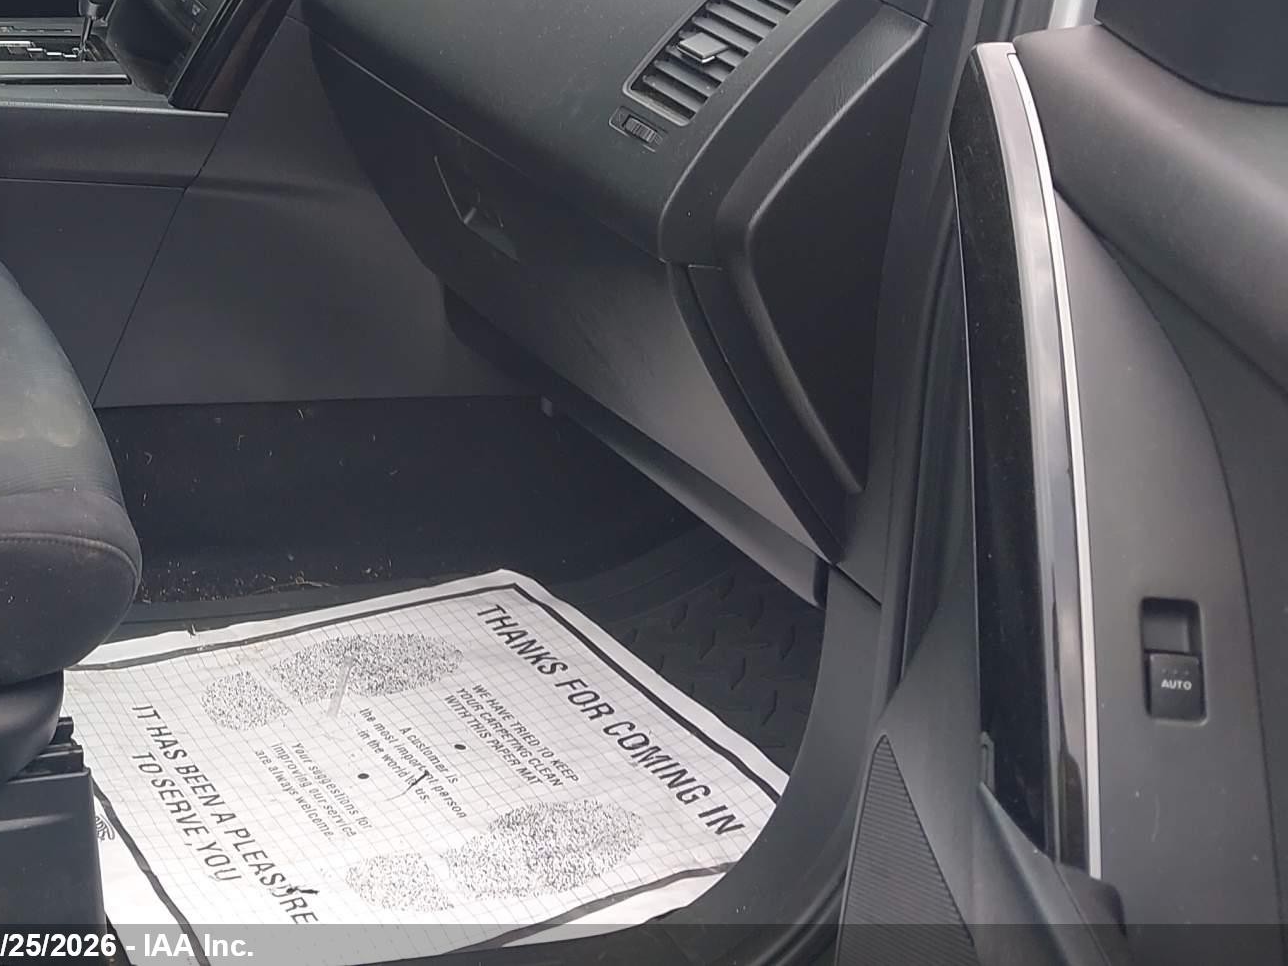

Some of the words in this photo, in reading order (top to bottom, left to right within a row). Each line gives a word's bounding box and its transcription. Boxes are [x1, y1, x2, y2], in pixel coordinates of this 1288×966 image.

[132, 705, 161, 720] IT
[477, 604, 569, 675] THANKS
[555, 678, 615, 720] FOR
[603, 721, 711, 805] COMING
[698, 805, 746, 835] IN
[1160, 679, 1192, 691] AUTO
[146, 725, 187, 760] HAS
[357, 729, 371, 740] in
[367, 739, 385, 754] the
[381, 753, 412, 778] world
[359, 707, 376, 722] the
[373, 723, 399, 744] most
[394, 743, 440, 784] importnt
[430, 785, 468, 818] person
[399, 726, 412, 735] A
[407, 735, 449, 773] customer
[445, 774, 458, 784] is
[444, 695, 472, 719] WITH
[467, 718, 492, 739] THIS
[486, 738, 521, 766] PAPER
[516, 767, 543, 785] MAT
[456, 688, 484, 712] YOUR
[479, 712, 532, 758] CARPETING
[528, 758, 563, 786] CLEAN
[472, 684, 491, 699] WE
[486, 698, 515, 721] HAVE
[510, 721, 541, 747] TRIED
[537, 746, 554, 759] TO
[551, 759, 579, 782] KEEP
[132, 752, 163, 773] TO
[196, 841, 242, 880] YOU
[175, 764, 225, 806] BEEN
[210, 813, 237, 824] A
[255, 750, 272, 765] are
[268, 766, 299, 795] always
[295, 796, 334, 842] welcome.
[291, 742, 312, 763] Your
[308, 765, 359, 816] suggestions
[355, 816, 373, 829] for
[309, 788, 327, 804] our
[323, 804, 357, 837] service
[224, 828, 319, 924] PLEASURE
